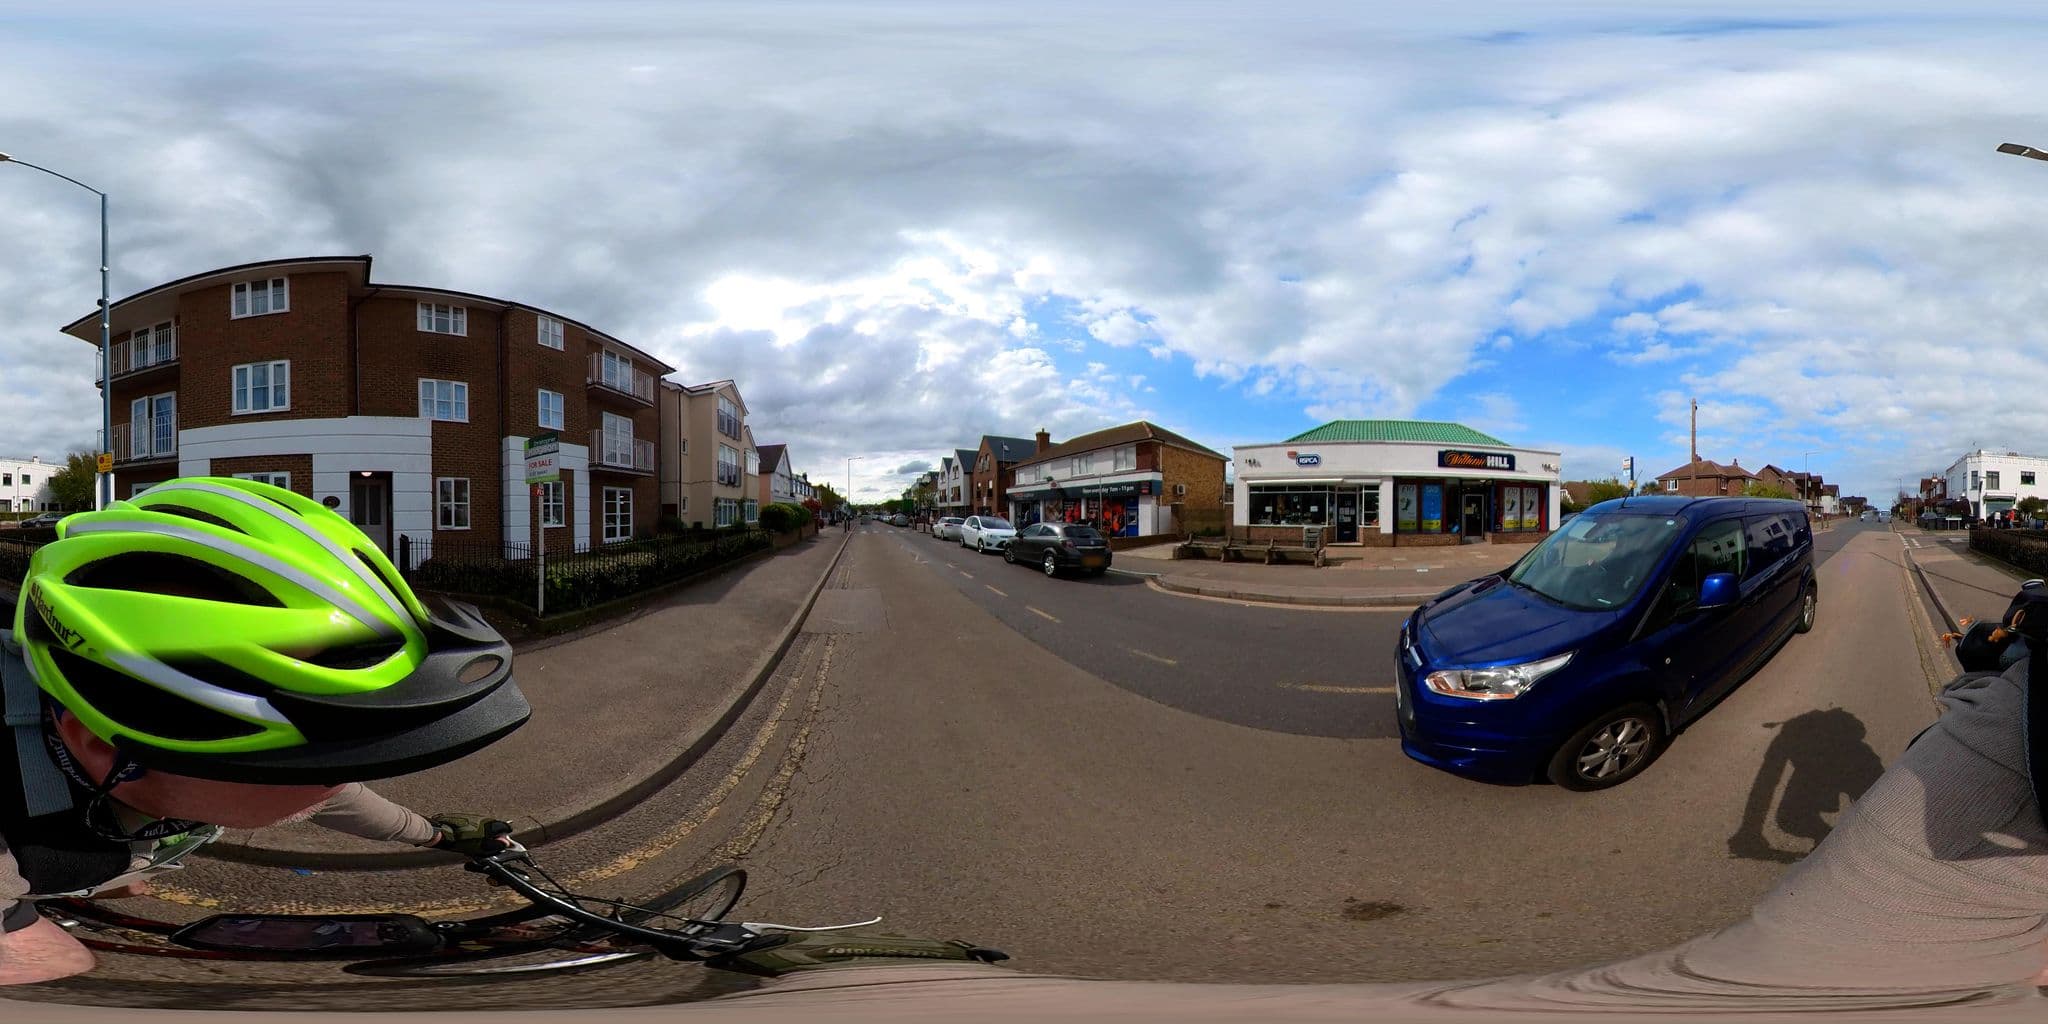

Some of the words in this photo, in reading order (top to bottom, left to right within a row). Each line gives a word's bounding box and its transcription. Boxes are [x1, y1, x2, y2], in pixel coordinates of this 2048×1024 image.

[529, 461, 538, 469] FOR
[538, 459, 552, 467] SALE
[1444, 451, 1487, 466] William
[1487, 455, 1510, 468] HILL
